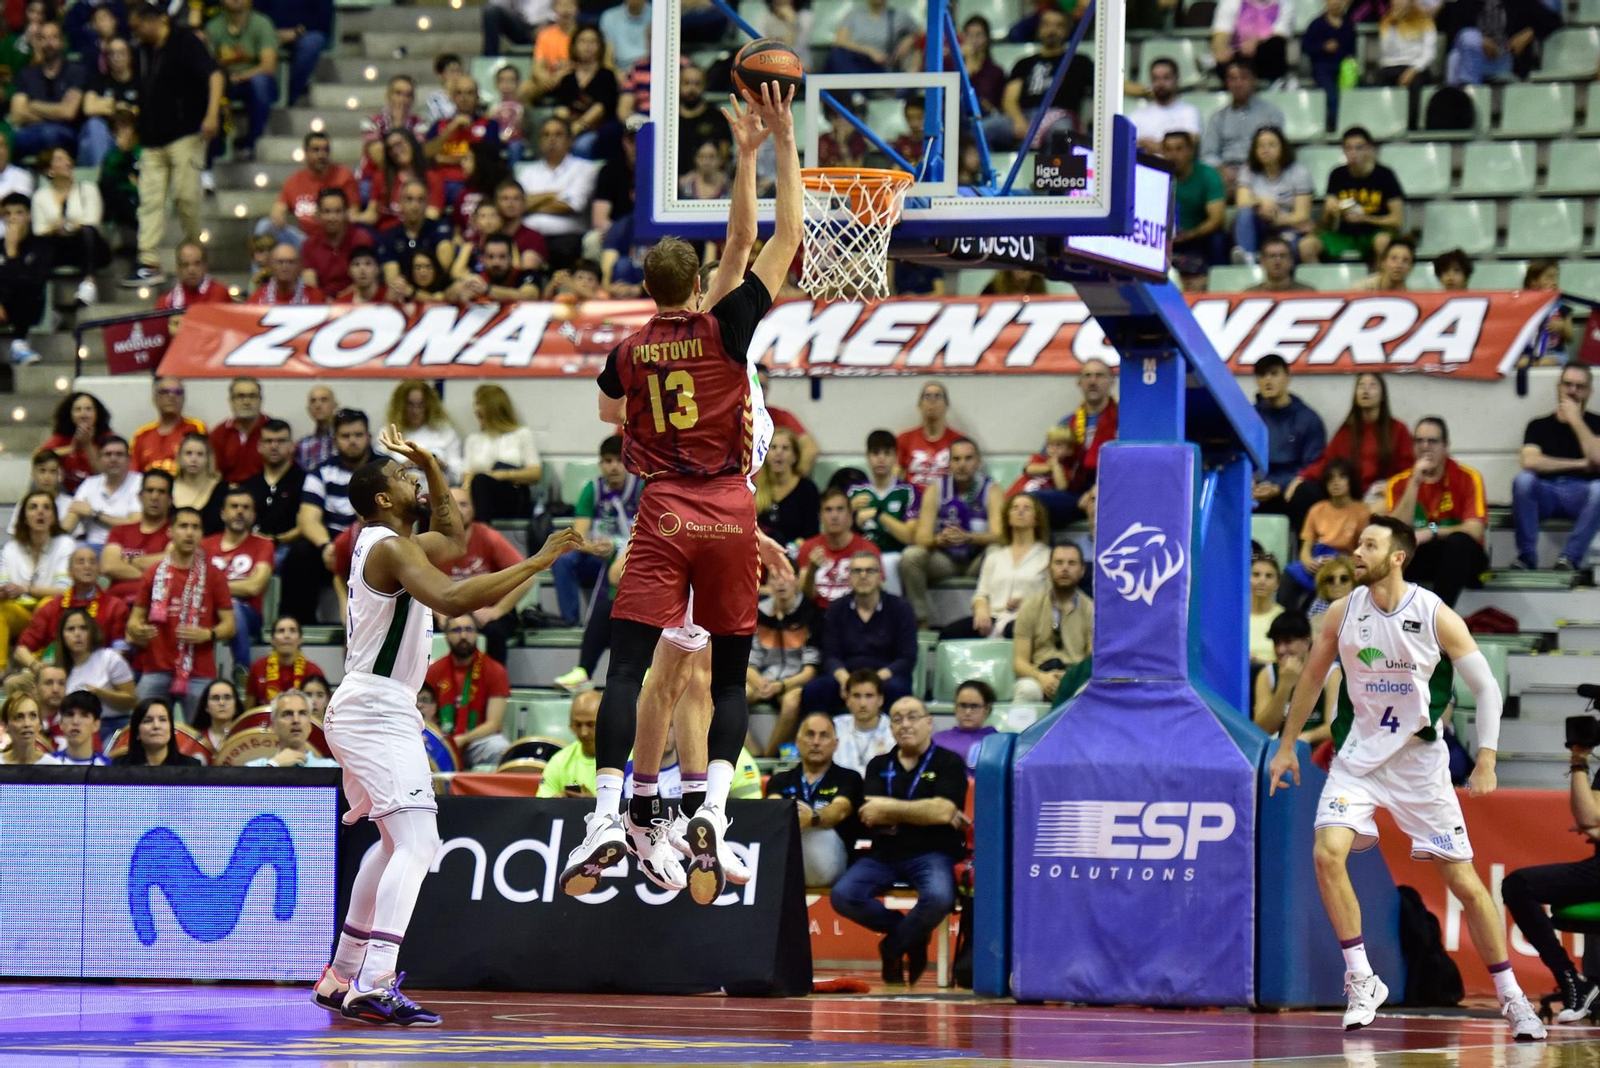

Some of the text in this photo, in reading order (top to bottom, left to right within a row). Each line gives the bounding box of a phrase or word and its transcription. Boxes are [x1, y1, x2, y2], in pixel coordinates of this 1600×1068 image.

[1036, 163, 1060, 177] liga
[1036, 175, 1086, 188] endesa
[224, 302, 555, 368] ZONA
[633, 338, 704, 365] PUSTOVYI
[647, 369, 699, 434] 13
[685, 521, 743, 534] Costa Cálida
[1380, 705, 1400, 734] 4
[1090, 801, 1237, 861] ESP
[1029, 863, 1196, 882] SOLUTIONS
